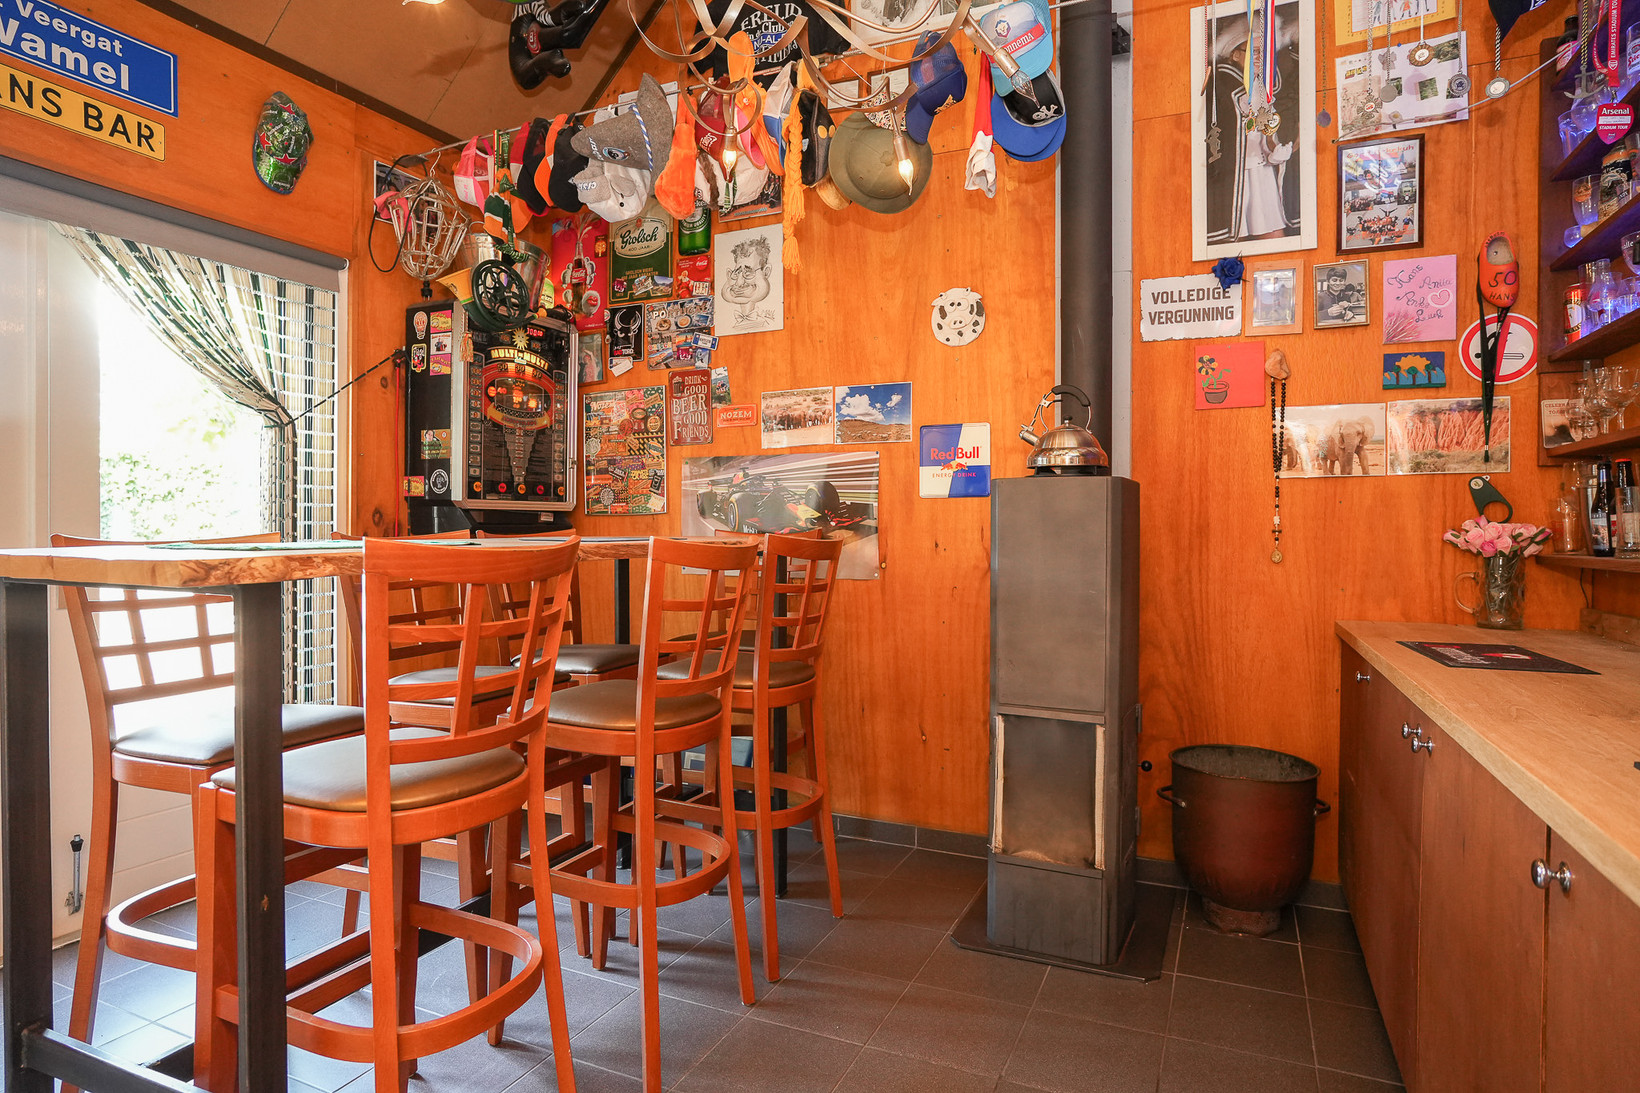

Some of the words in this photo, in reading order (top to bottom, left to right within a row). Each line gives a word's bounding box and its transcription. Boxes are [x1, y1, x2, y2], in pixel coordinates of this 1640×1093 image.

[16, 0, 123, 57] Veergat
[761, 21, 785, 33] Club
[0, 73, 62, 118] NS
[83, 101, 155, 152] BAR
[1601, 107, 1630, 115] Arsenal
[620, 226, 659, 249] Grolsch
[1488, 270, 1518, 288] 50
[1151, 286, 1232, 305] VOLLEDIGE
[1488, 291, 1516, 302] HANS
[1148, 305, 1235, 325] VERGUNNING
[684, 375, 702, 385] DRINK
[684, 384, 708, 396] GOOD
[672, 394, 708, 415] BEER
[683, 411, 708, 425] GOOD
[720, 410, 752, 420] NOZEM
[673, 420, 709, 440] FRIENDS
[930, 447, 955, 460] Red
[956, 446, 979, 459] Bull
